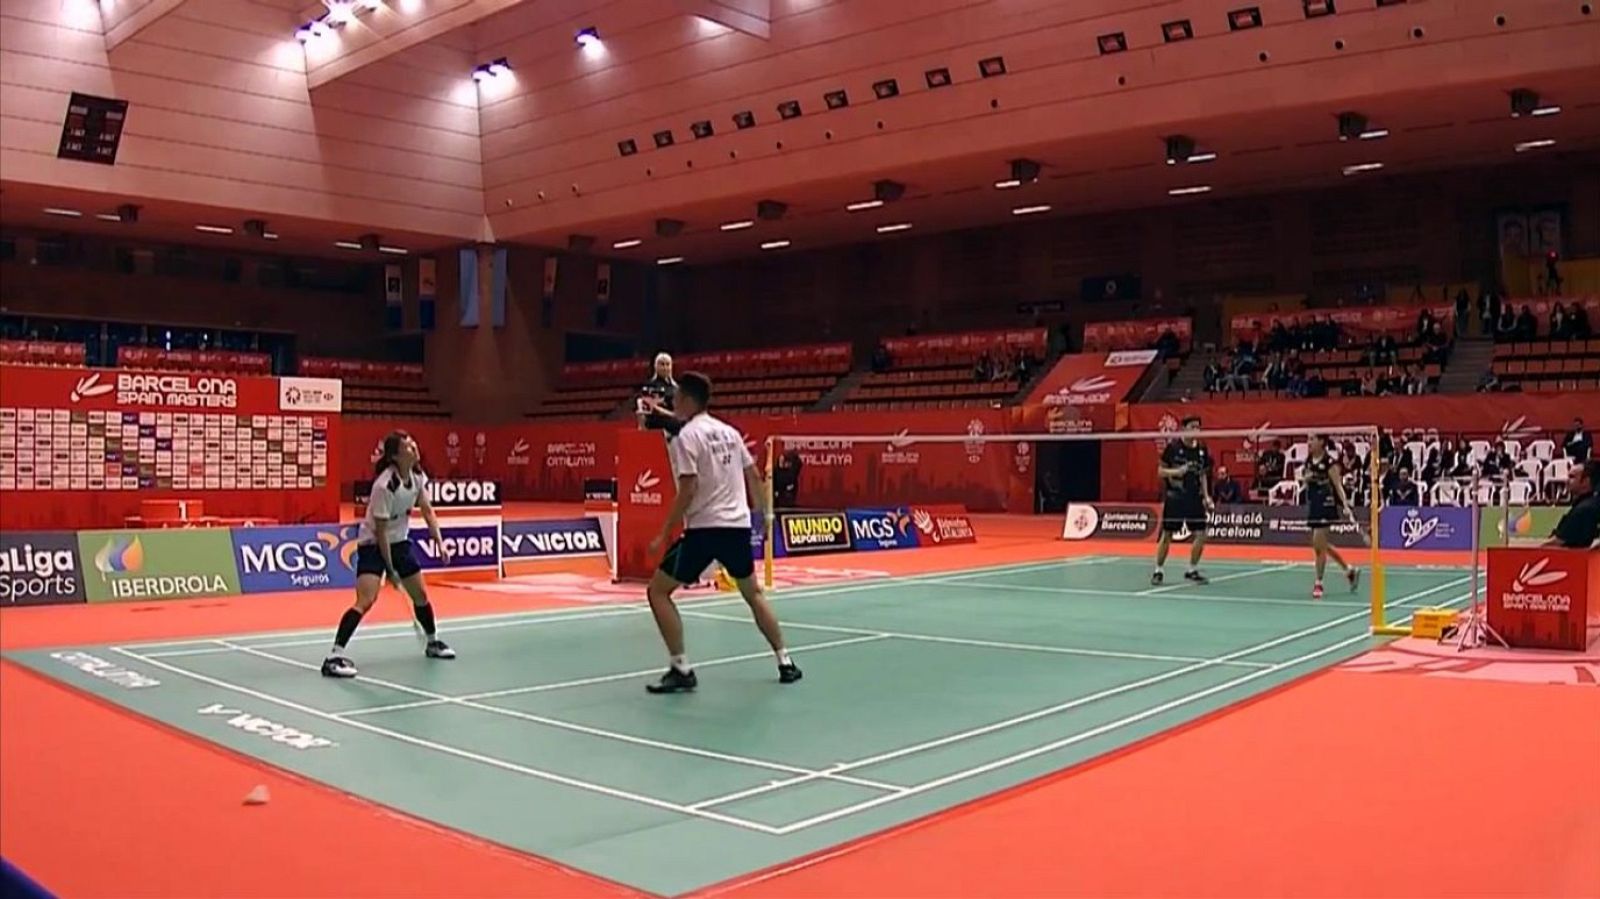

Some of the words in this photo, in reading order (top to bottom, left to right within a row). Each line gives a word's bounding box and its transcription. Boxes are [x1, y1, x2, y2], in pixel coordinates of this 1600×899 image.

[118, 374, 237, 393] BARCELONA
[117, 392, 163, 404] SPAIN
[166, 394, 237, 407] MASTERS
[799, 453, 852, 466] TALUNYA
[178, 500, 187, 521] 1
[788, 516, 843, 534] MUNDO
[852, 518, 895, 540] MGS
[1101, 520, 1147, 530] Barcelona
[1207, 526, 1261, 538] arcelona
[417, 536, 493, 558] VICTOR
[527, 531, 601, 551] VICTOR
[791, 533, 836, 544] DEPORTIVO
[241, 541, 327, 573] MGS
[0, 574, 76, 602] Sports
[112, 575, 229, 597] IBERDROLA
[291, 573, 330, 587] Seguros
